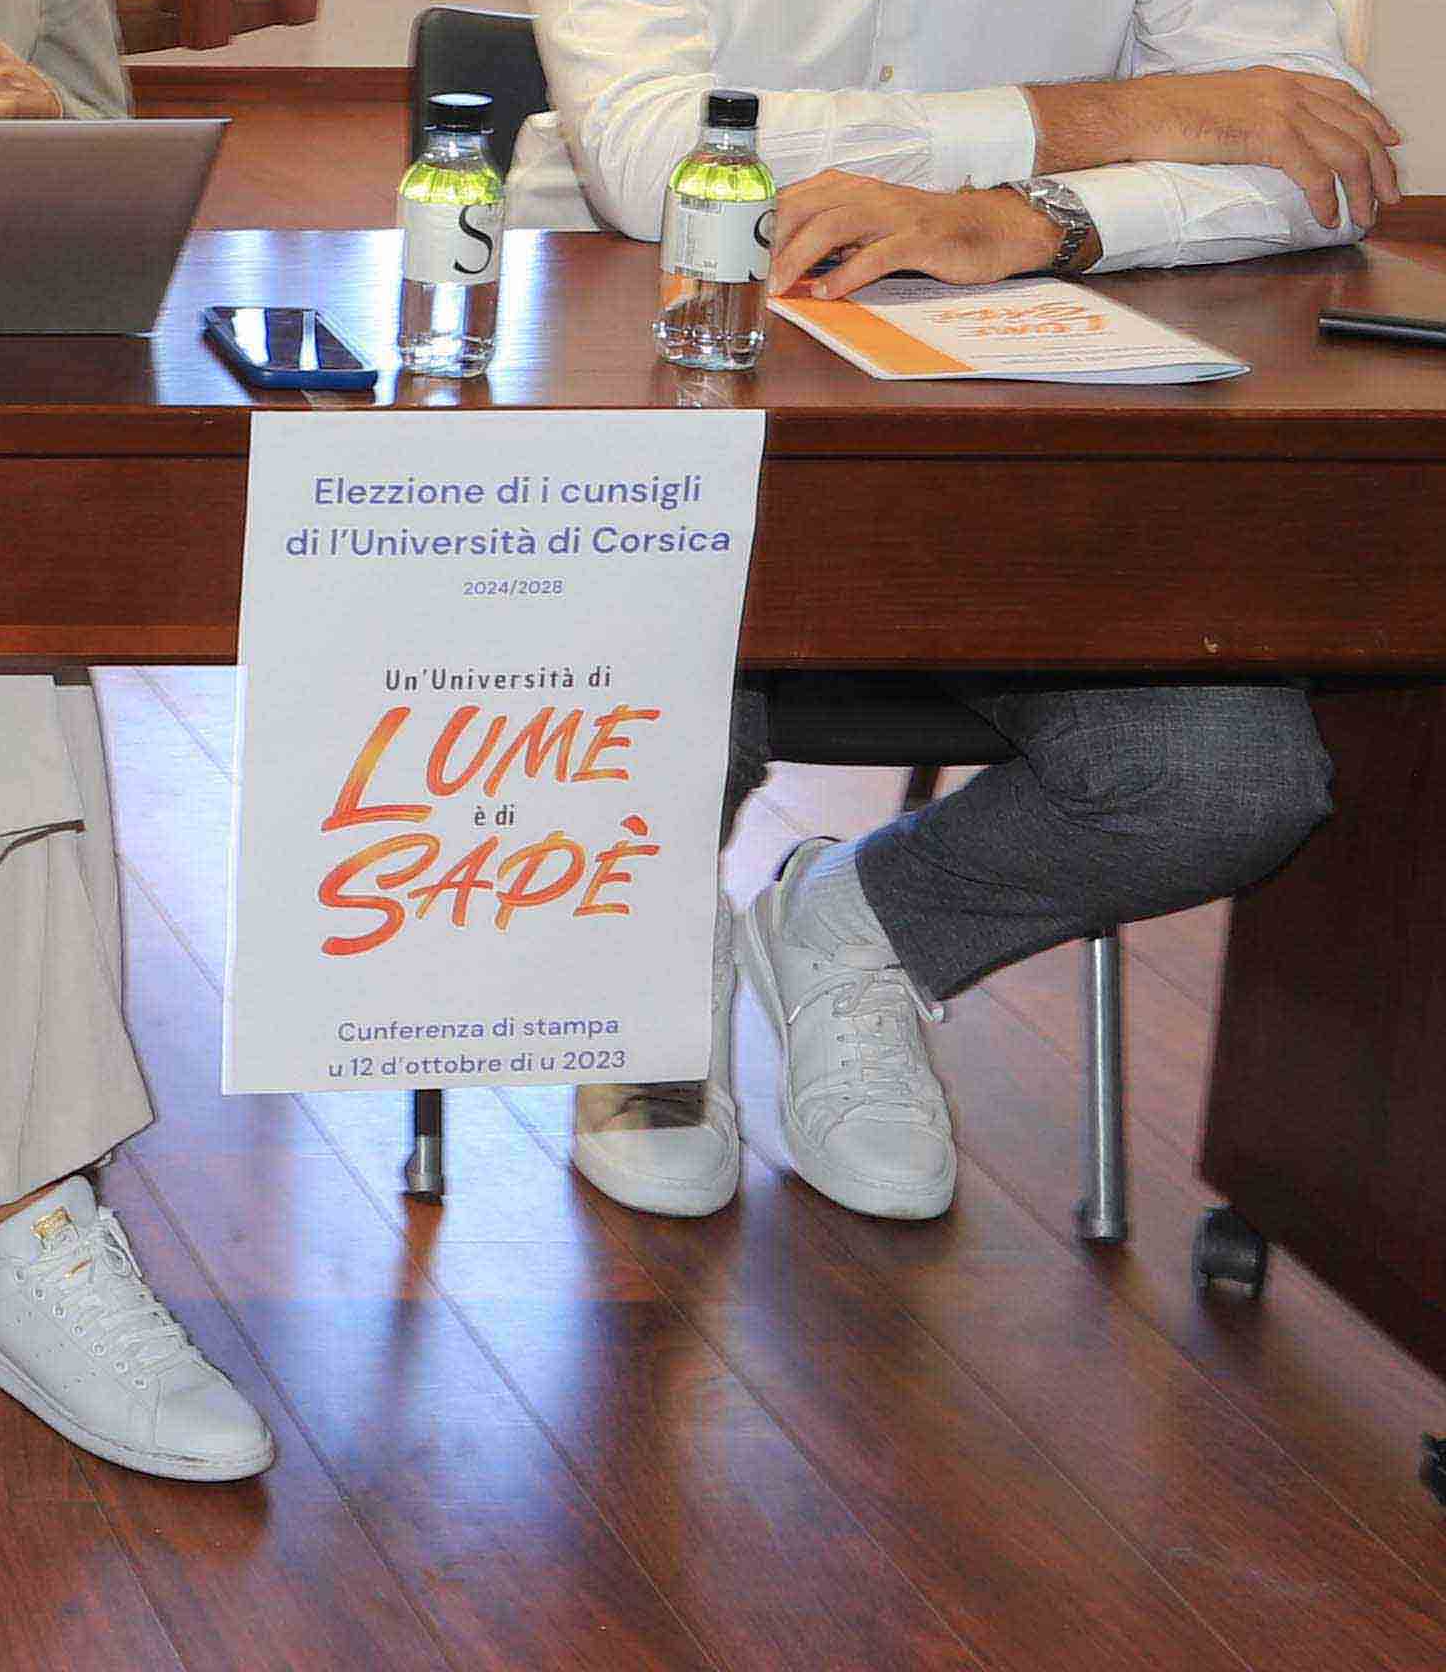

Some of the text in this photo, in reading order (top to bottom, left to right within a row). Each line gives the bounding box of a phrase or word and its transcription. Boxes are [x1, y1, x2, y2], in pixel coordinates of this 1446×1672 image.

[316, 475, 700, 512] Elezzione di i cunsigli
[286, 523, 730, 555] di l'Università di Corsica
[464, 579, 564, 596] 2024/2028
[386, 666, 610, 690] Un'Università di
[322, 705, 660, 831] LUME
[475, 804, 514, 826] è di
[319, 815, 659, 956] SAPÈ
[338, 1016, 618, 1041] Cunferenza di stampa
[329, 1051, 625, 1080] u 12 d'ottobre di u 2023
